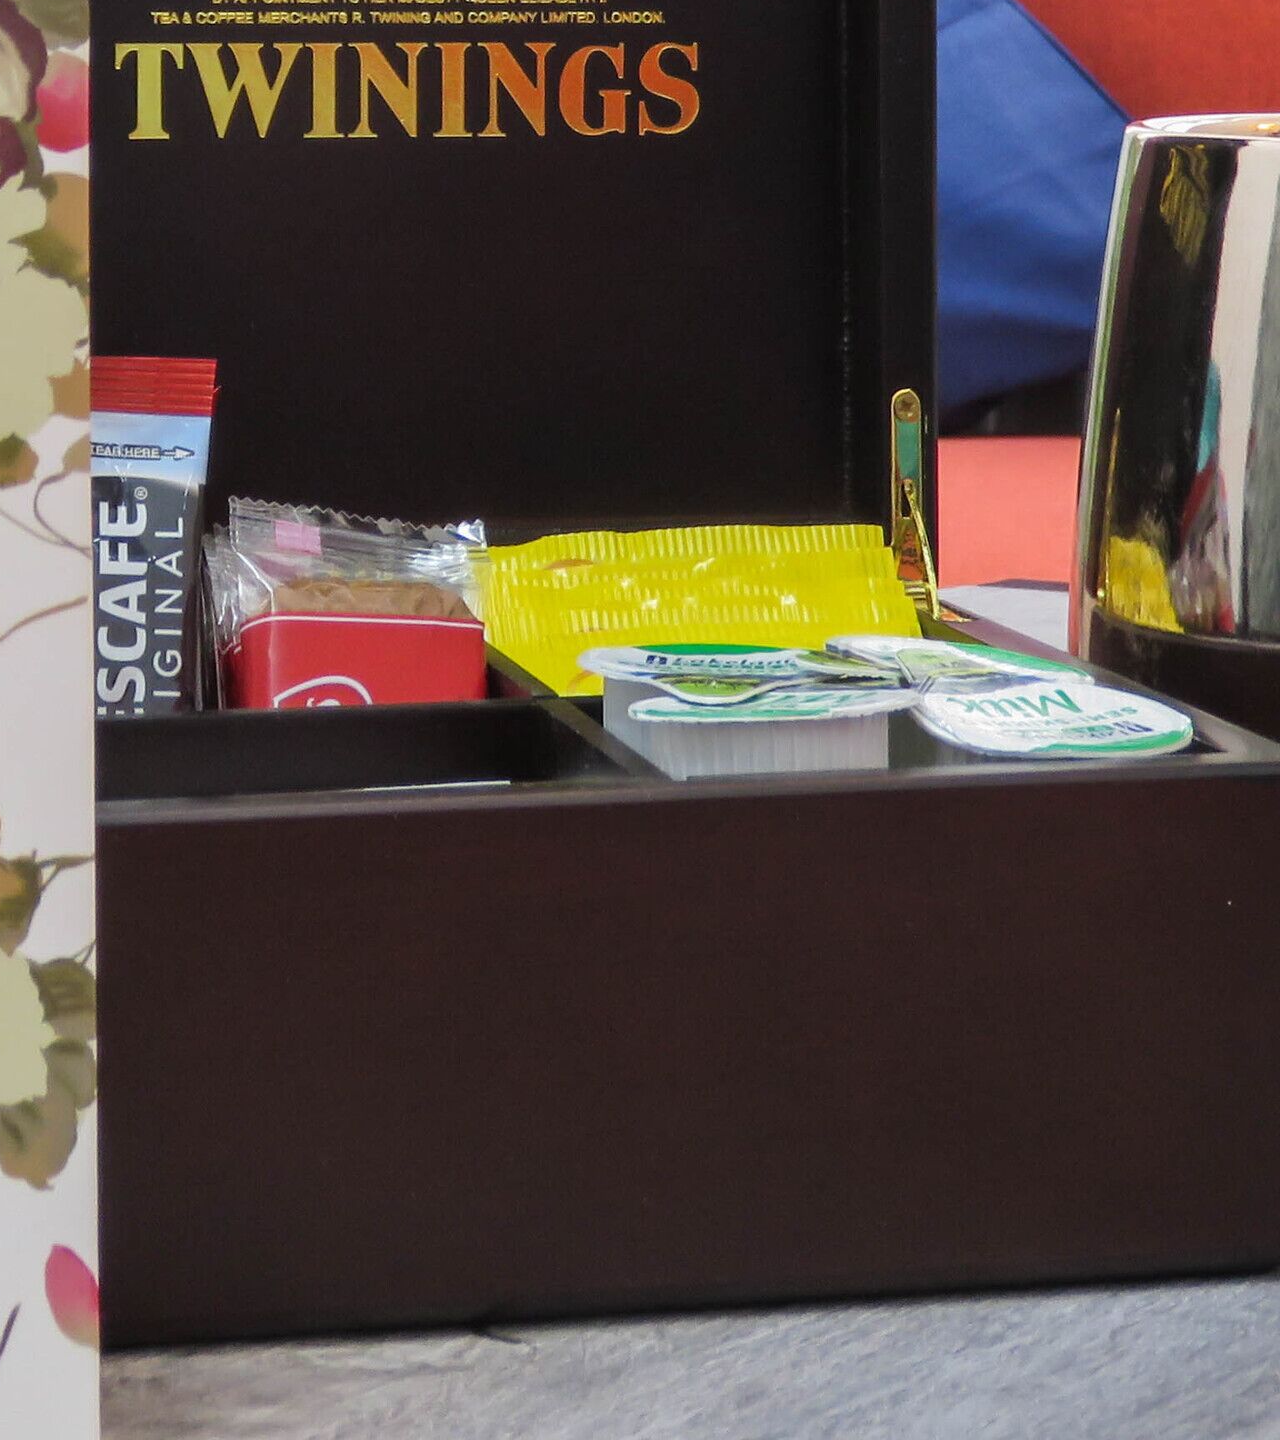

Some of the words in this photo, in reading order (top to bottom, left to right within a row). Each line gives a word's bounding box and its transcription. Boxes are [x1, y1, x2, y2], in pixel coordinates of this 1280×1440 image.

[151, 11, 180, 25] TEA
[182, 11, 192, 25] &
[196, 11, 254, 25] COFFEE
[258, 11, 347, 25] MERCHANTS
[370, 11, 431, 25] TWINING
[433, 11, 464, 25] AND
[468, 11, 537, 25] COMPANY
[115, 42, 700, 139] TWININGS
[125, 446, 161, 459] HERE
[96, 501, 149, 715] SCAFE
[152, 516, 184, 698] IGINAL
[945, 689, 1083, 718] Milk
